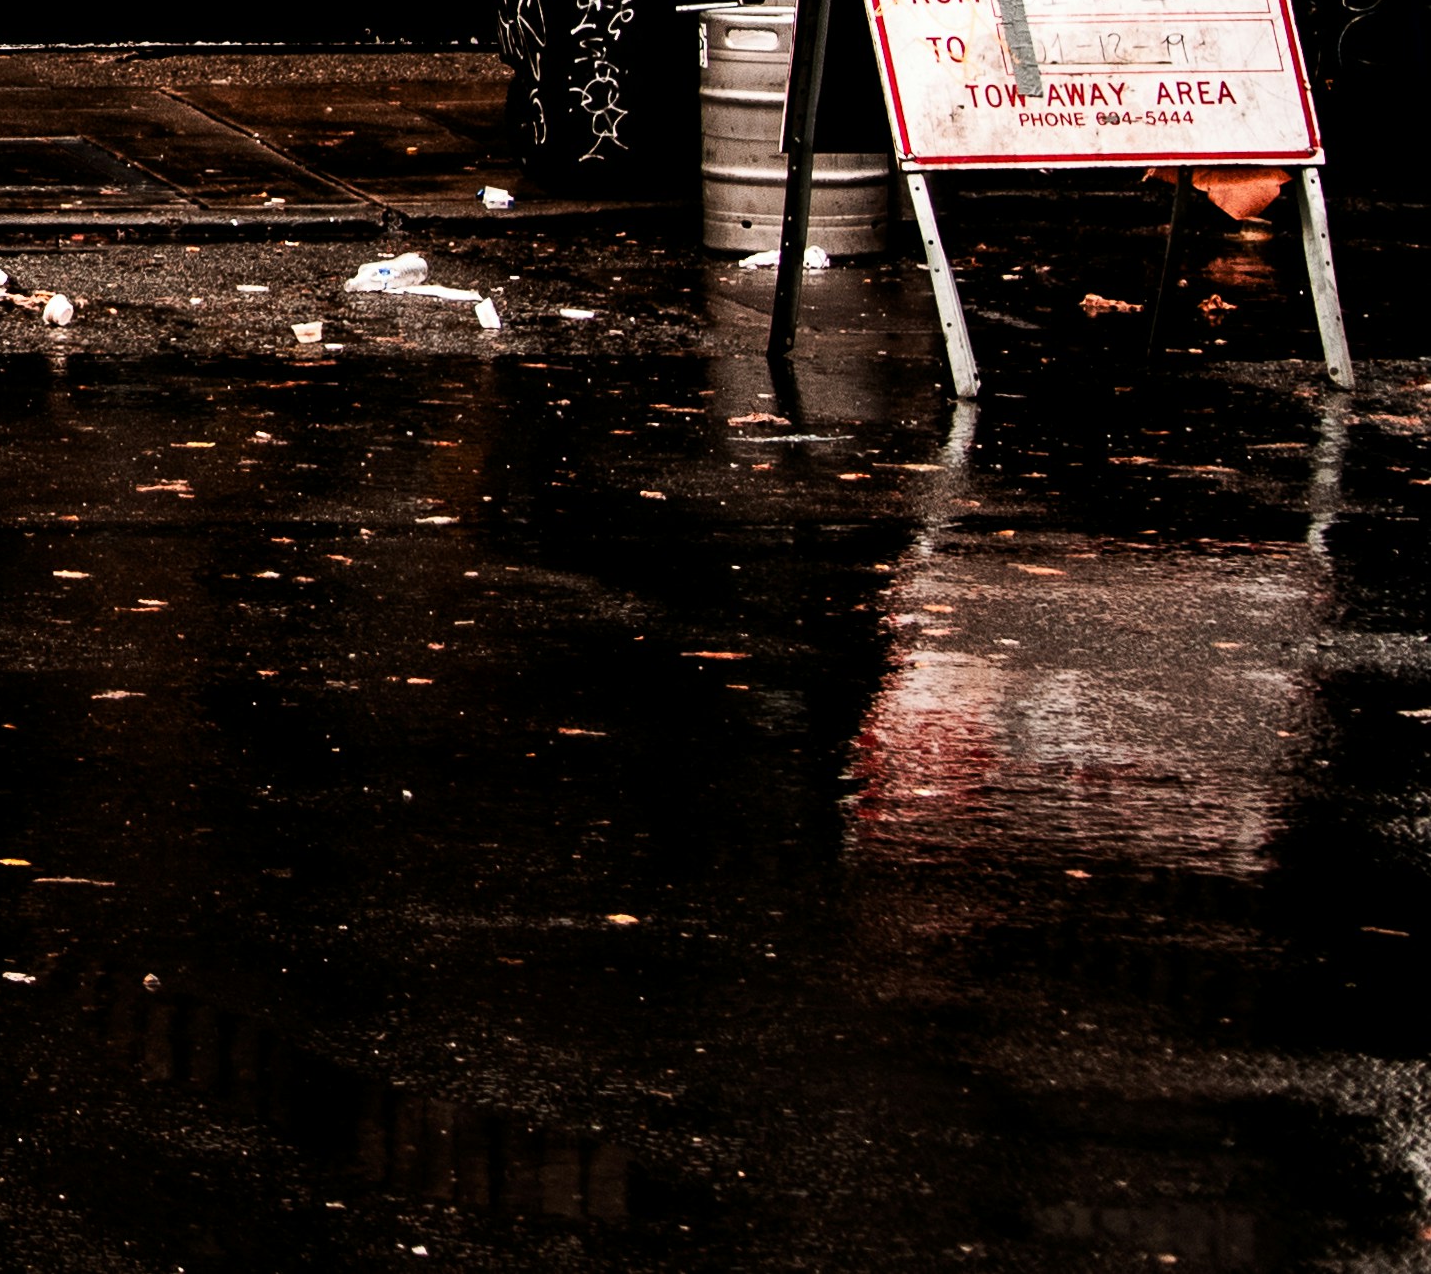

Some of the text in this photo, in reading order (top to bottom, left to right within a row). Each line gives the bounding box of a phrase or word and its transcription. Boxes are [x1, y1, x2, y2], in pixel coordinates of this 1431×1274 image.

[927, 35, 966, 64] TO
[1156, 80, 1238, 108] AREA
[1018, 111, 1086, 128] PHONE
